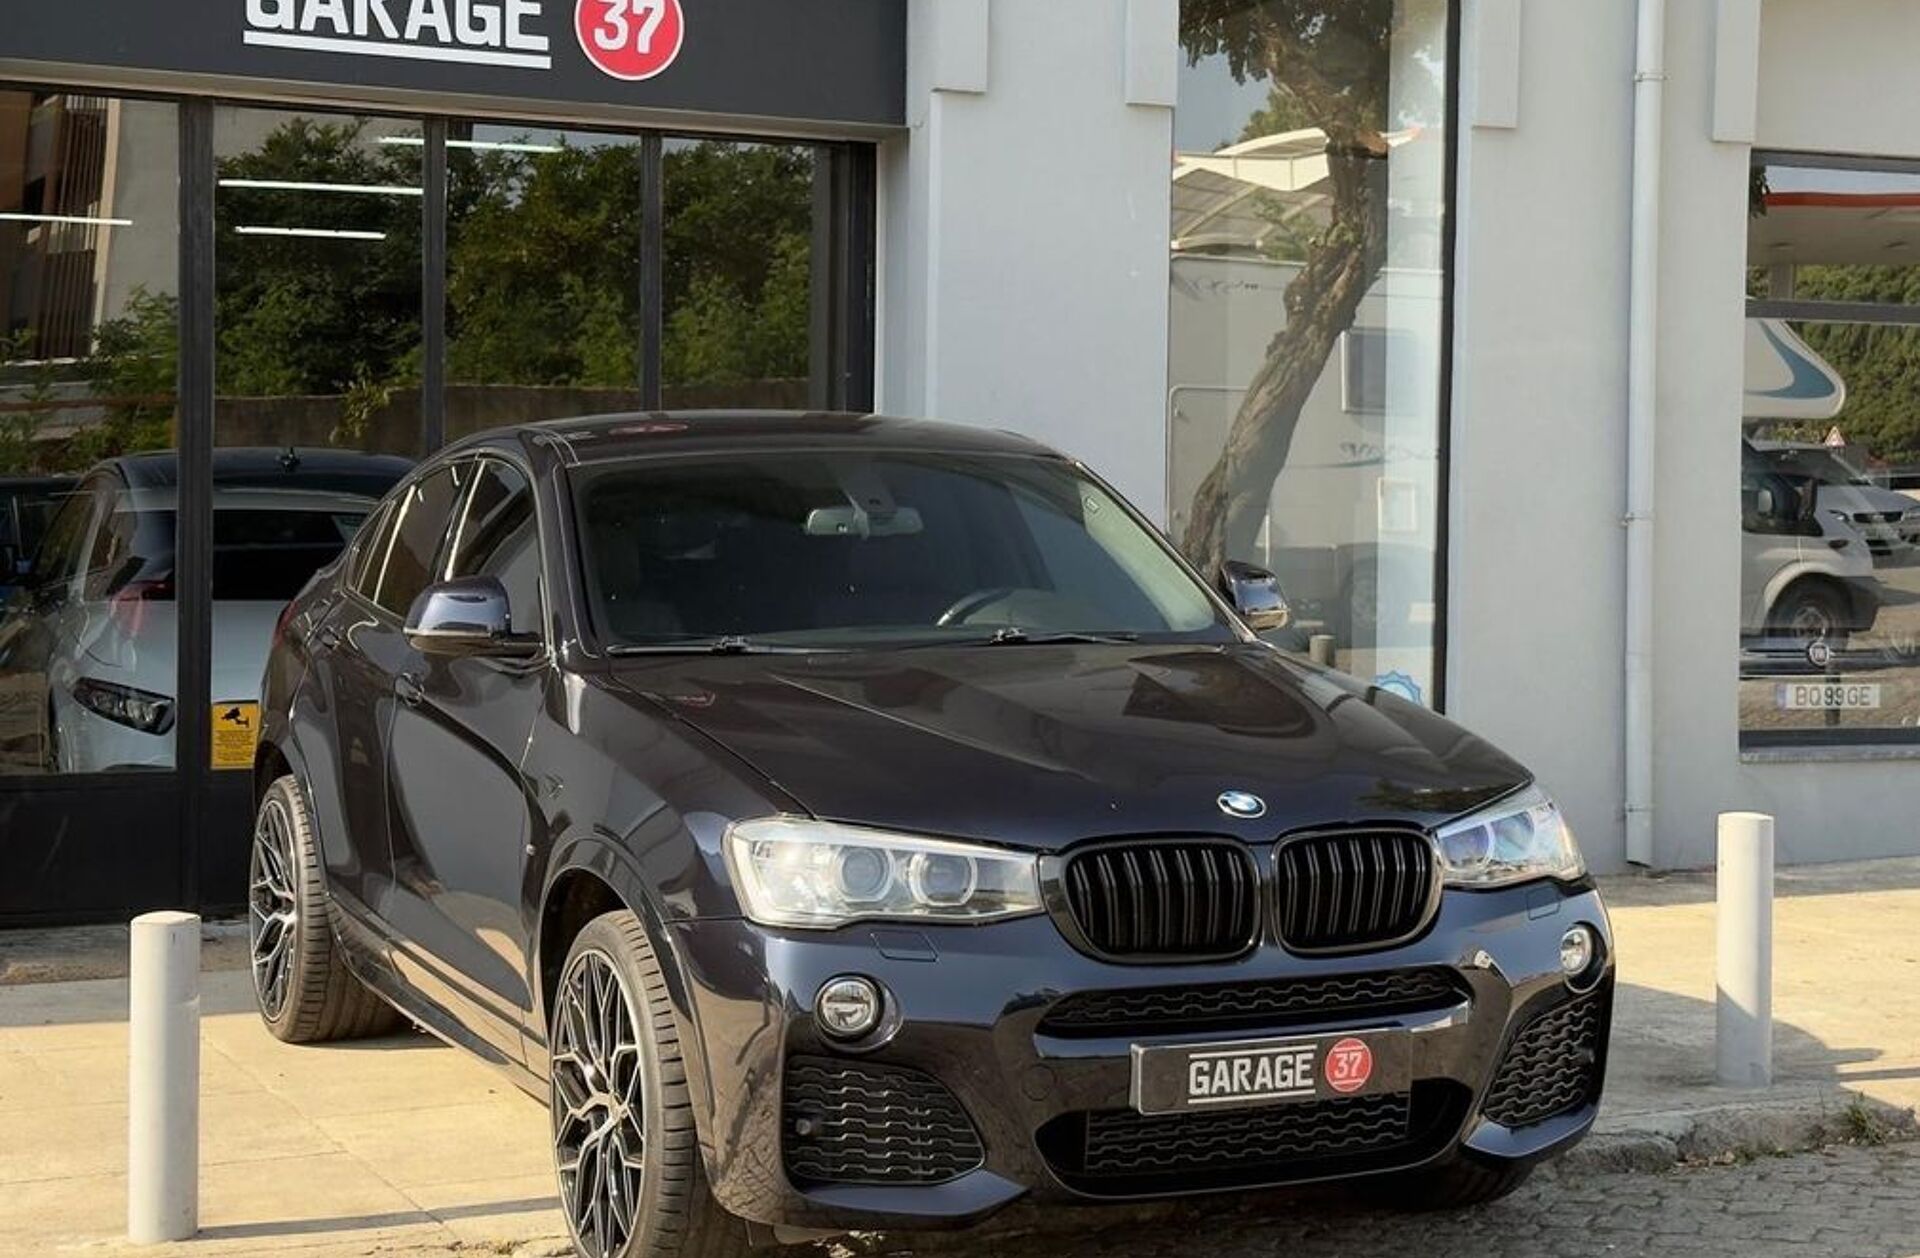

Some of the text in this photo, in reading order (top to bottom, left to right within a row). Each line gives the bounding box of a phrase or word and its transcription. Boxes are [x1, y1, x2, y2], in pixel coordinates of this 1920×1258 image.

[594, 0, 667, 54] 37
[1189, 1052, 1361, 1096] GARAGE 37
